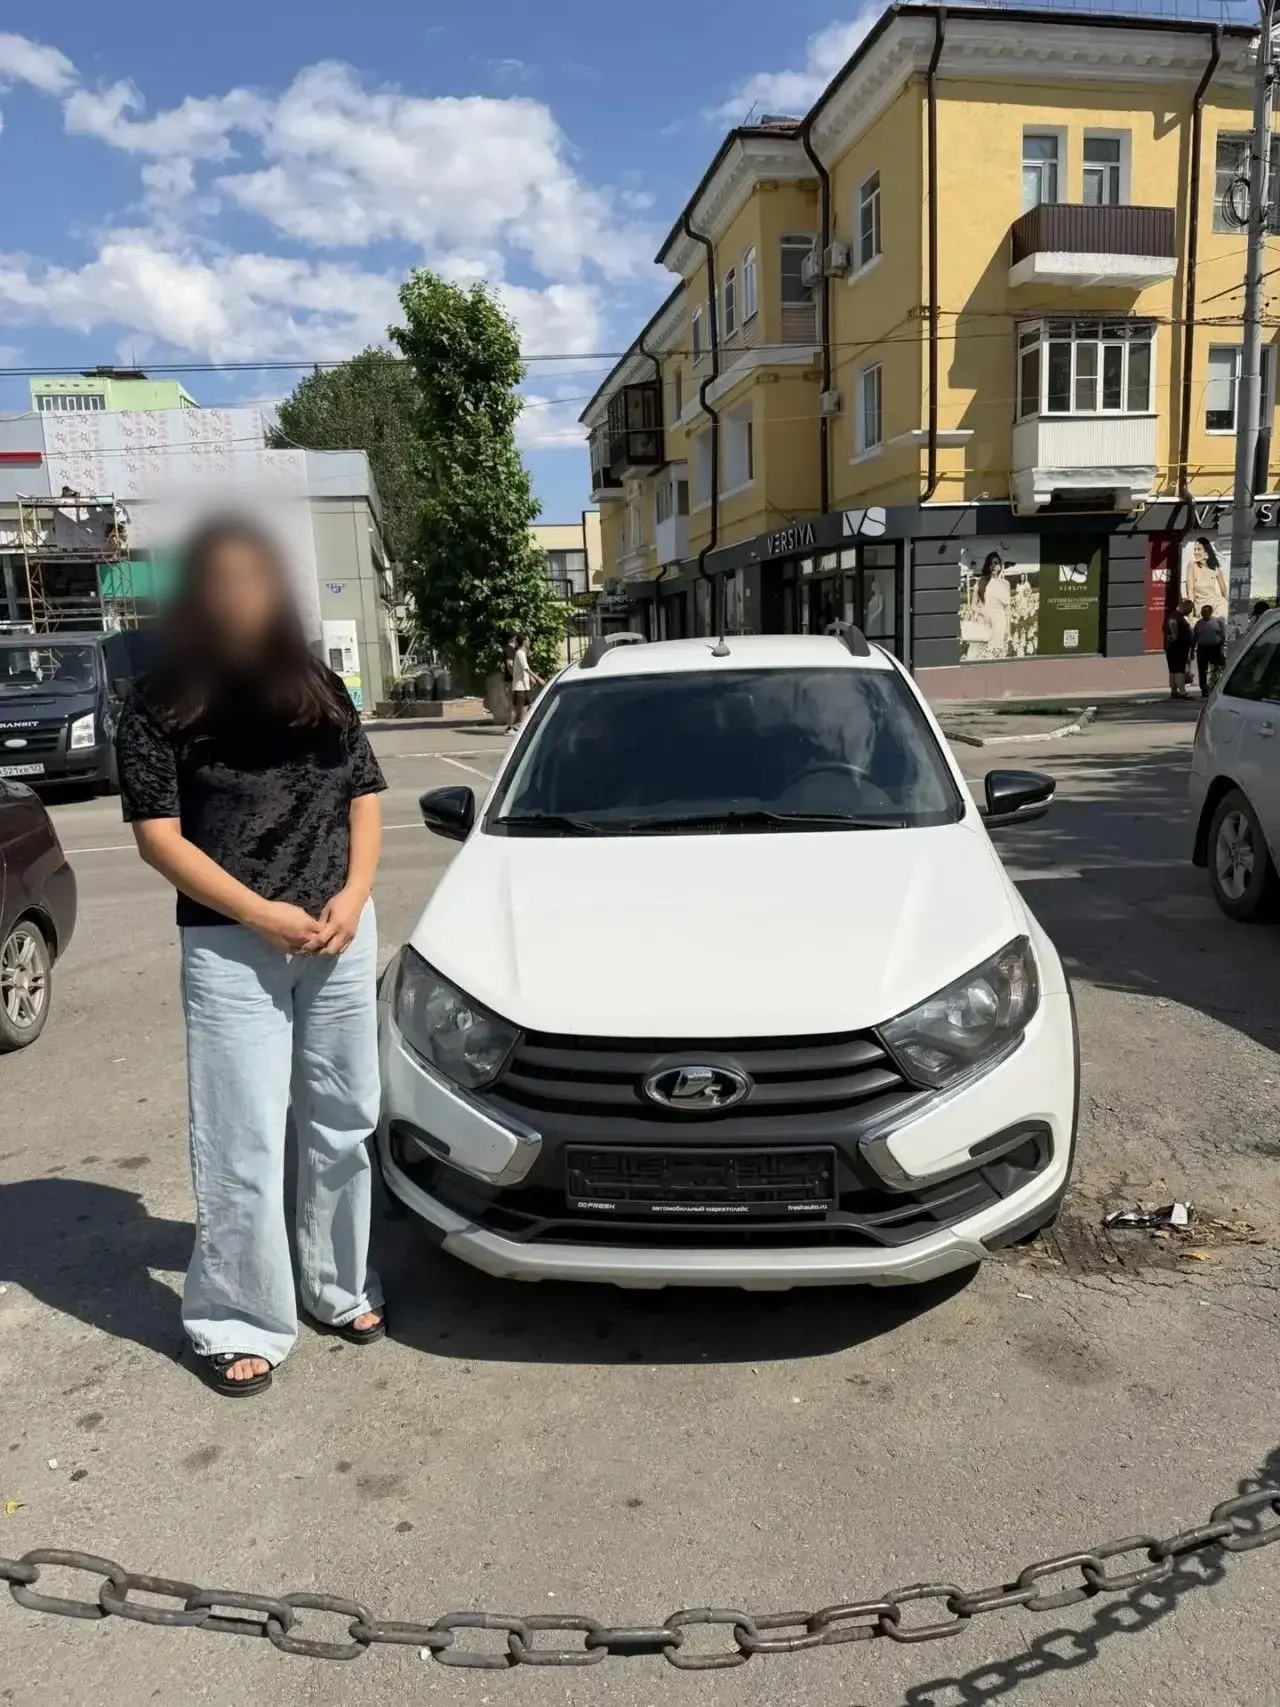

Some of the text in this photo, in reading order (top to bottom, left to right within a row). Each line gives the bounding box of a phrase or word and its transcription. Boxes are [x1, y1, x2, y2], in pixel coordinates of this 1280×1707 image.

[843, 506, 887, 536] VS
[767, 523, 814, 554] VERSIYA
[1059, 563, 1087, 583] VS
